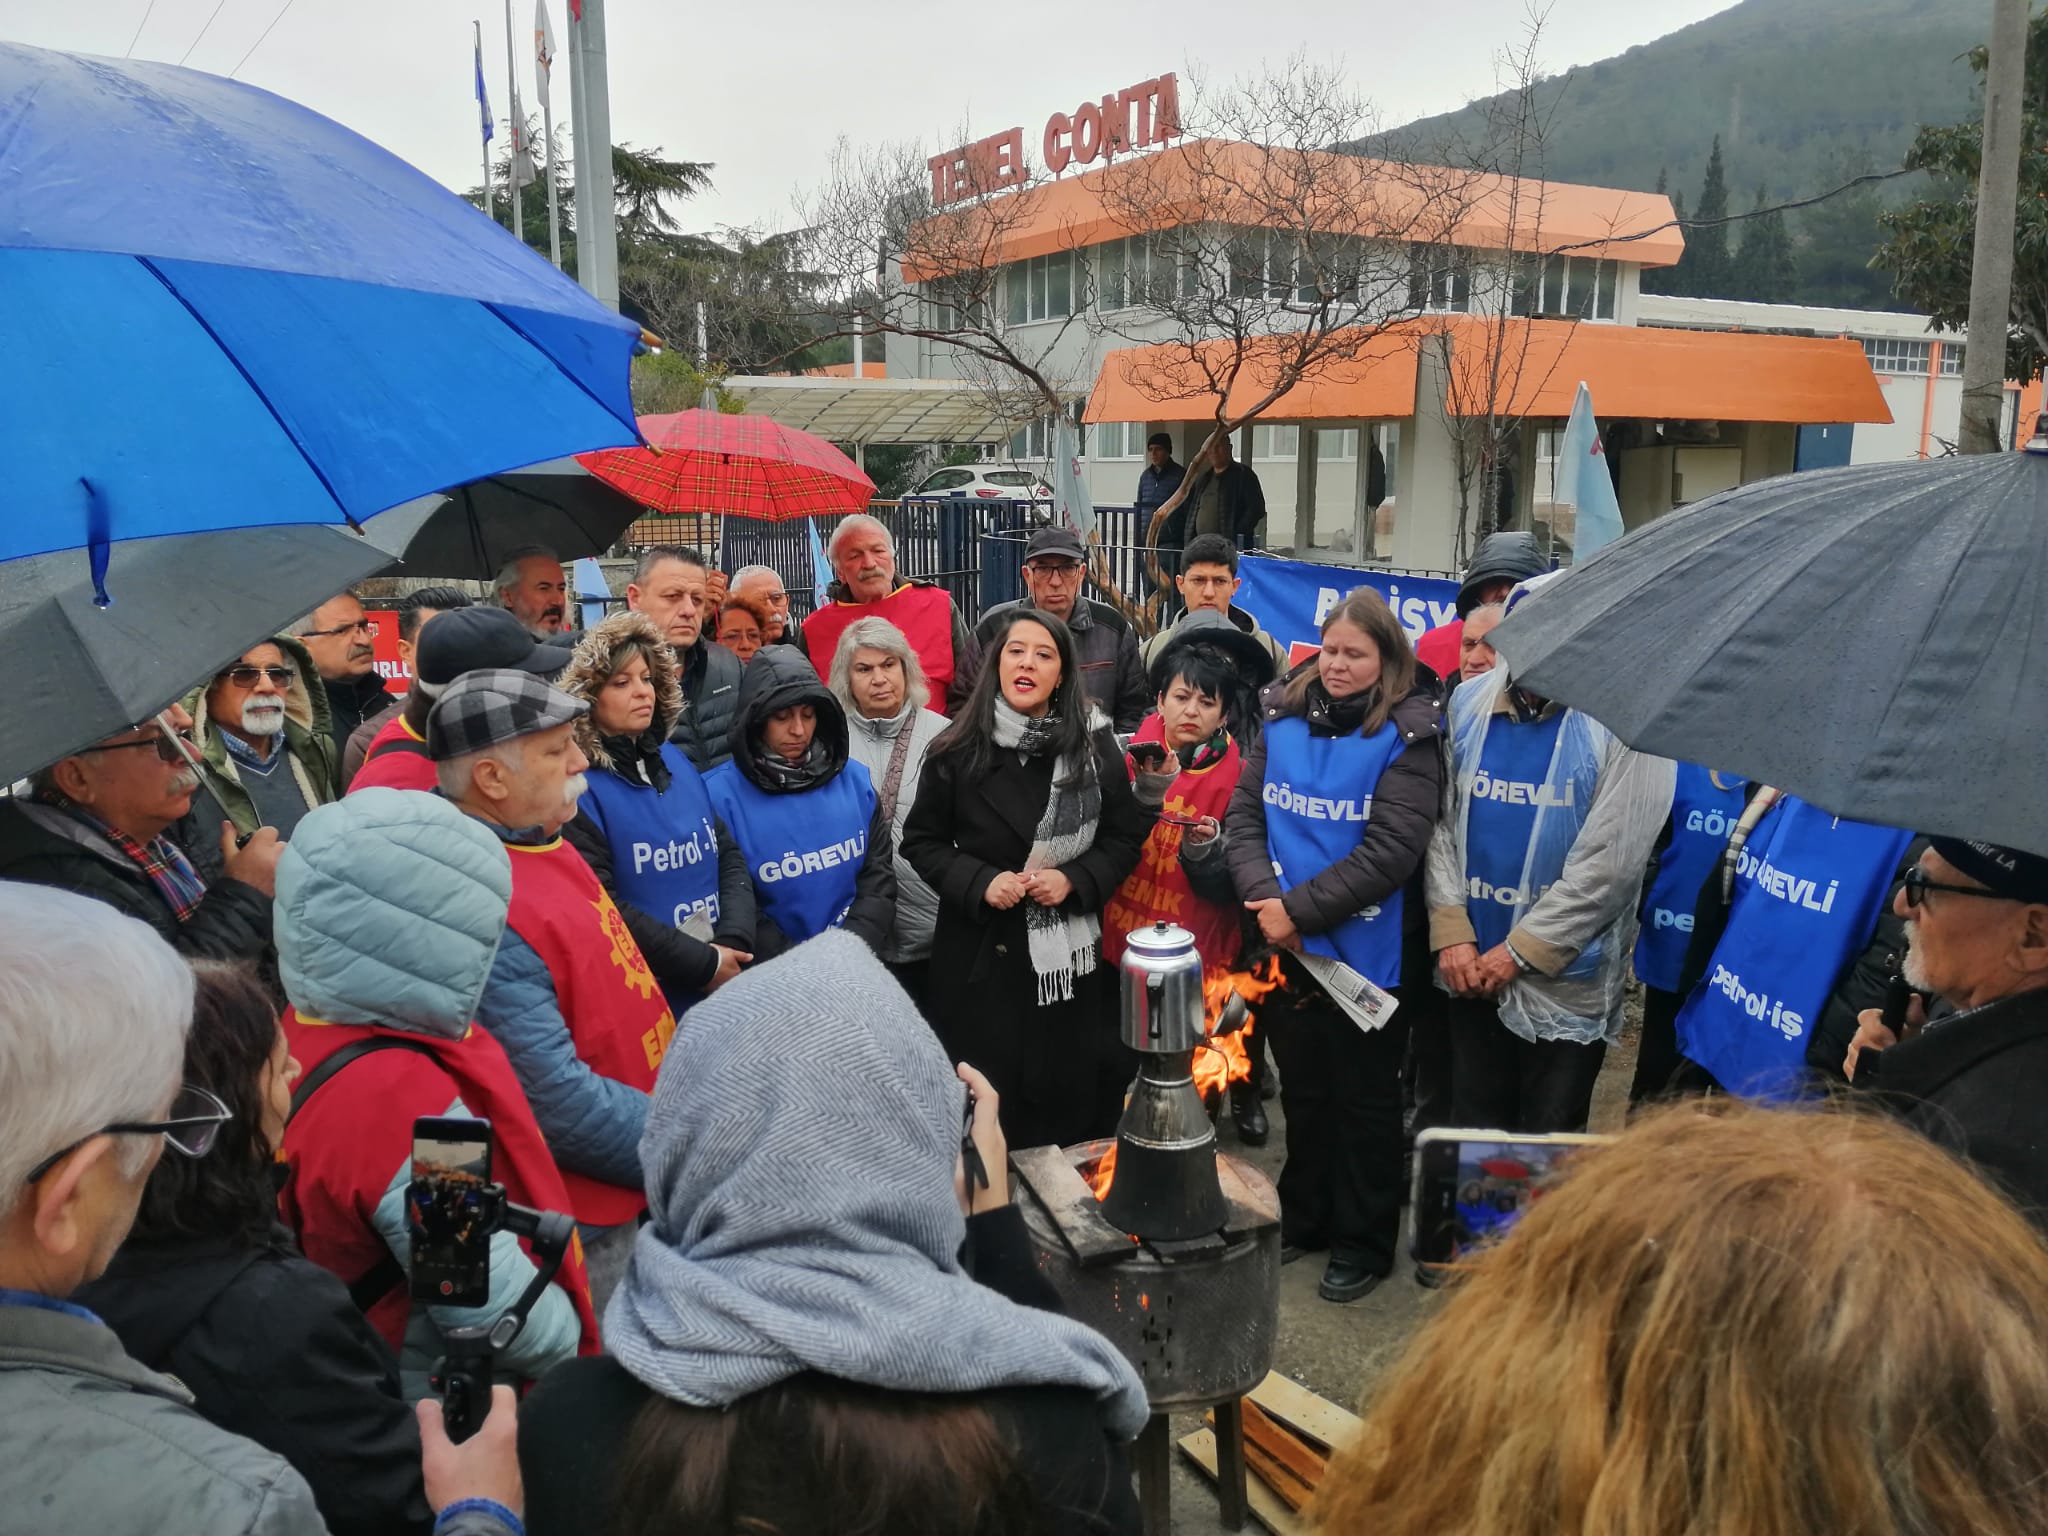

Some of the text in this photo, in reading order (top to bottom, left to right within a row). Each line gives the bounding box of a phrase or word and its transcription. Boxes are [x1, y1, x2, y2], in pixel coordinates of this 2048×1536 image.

[1043, 72, 1181, 172] CONTA
[1262, 782, 1372, 821] GÖREVLİ
[1465, 769, 1575, 807] ÖREVLİ
[759, 830, 865, 883] GÖREVLİ
[1121, 874, 1185, 917] EMEK
